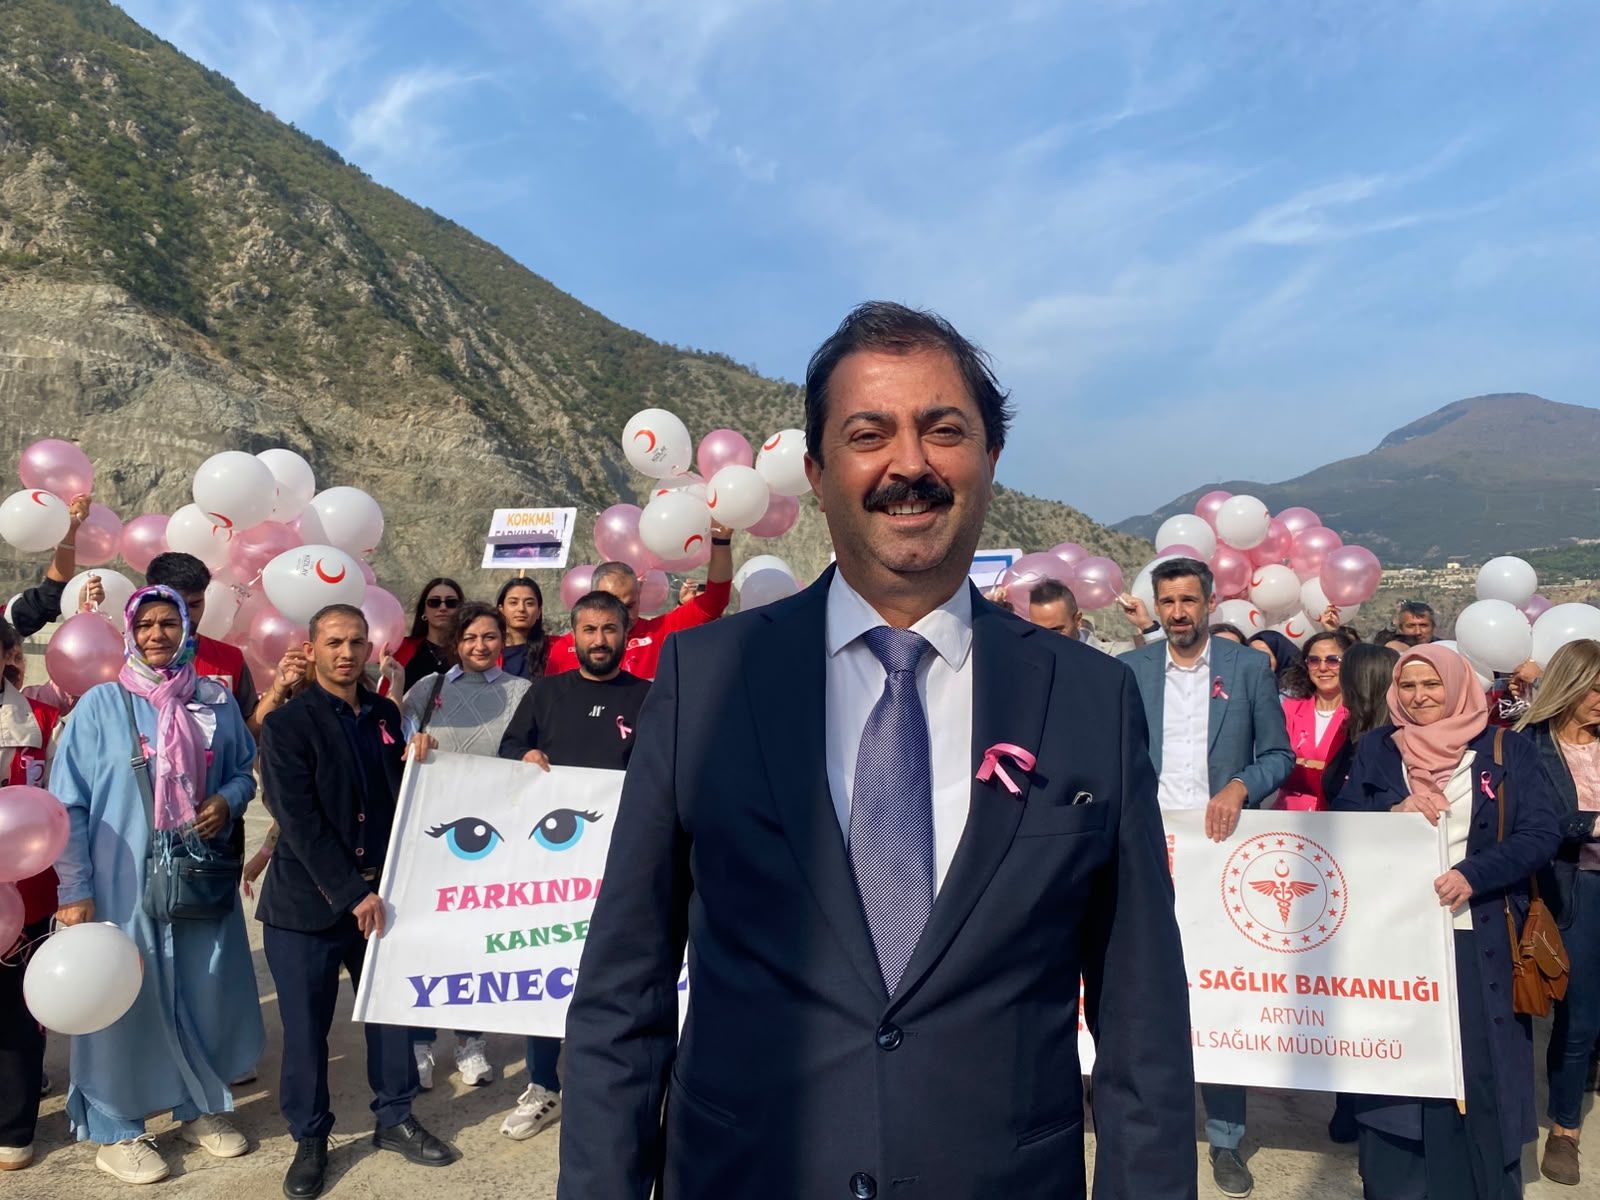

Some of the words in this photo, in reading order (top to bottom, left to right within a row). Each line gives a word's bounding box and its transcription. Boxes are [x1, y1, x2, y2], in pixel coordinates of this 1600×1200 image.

[506, 512, 554, 526] KORKMA!
[406, 966, 579, 1008] YENEC
[1199, 966, 1288, 993] SAĞLIK
[1295, 974, 1440, 1002] BAKANLIĞI
[1260, 1005, 1325, 1027] ARTVİN
[1208, 1029, 1272, 1052] SAĞLIK
[1277, 1033, 1402, 1060] MÜDÜRLÜĞÜ
